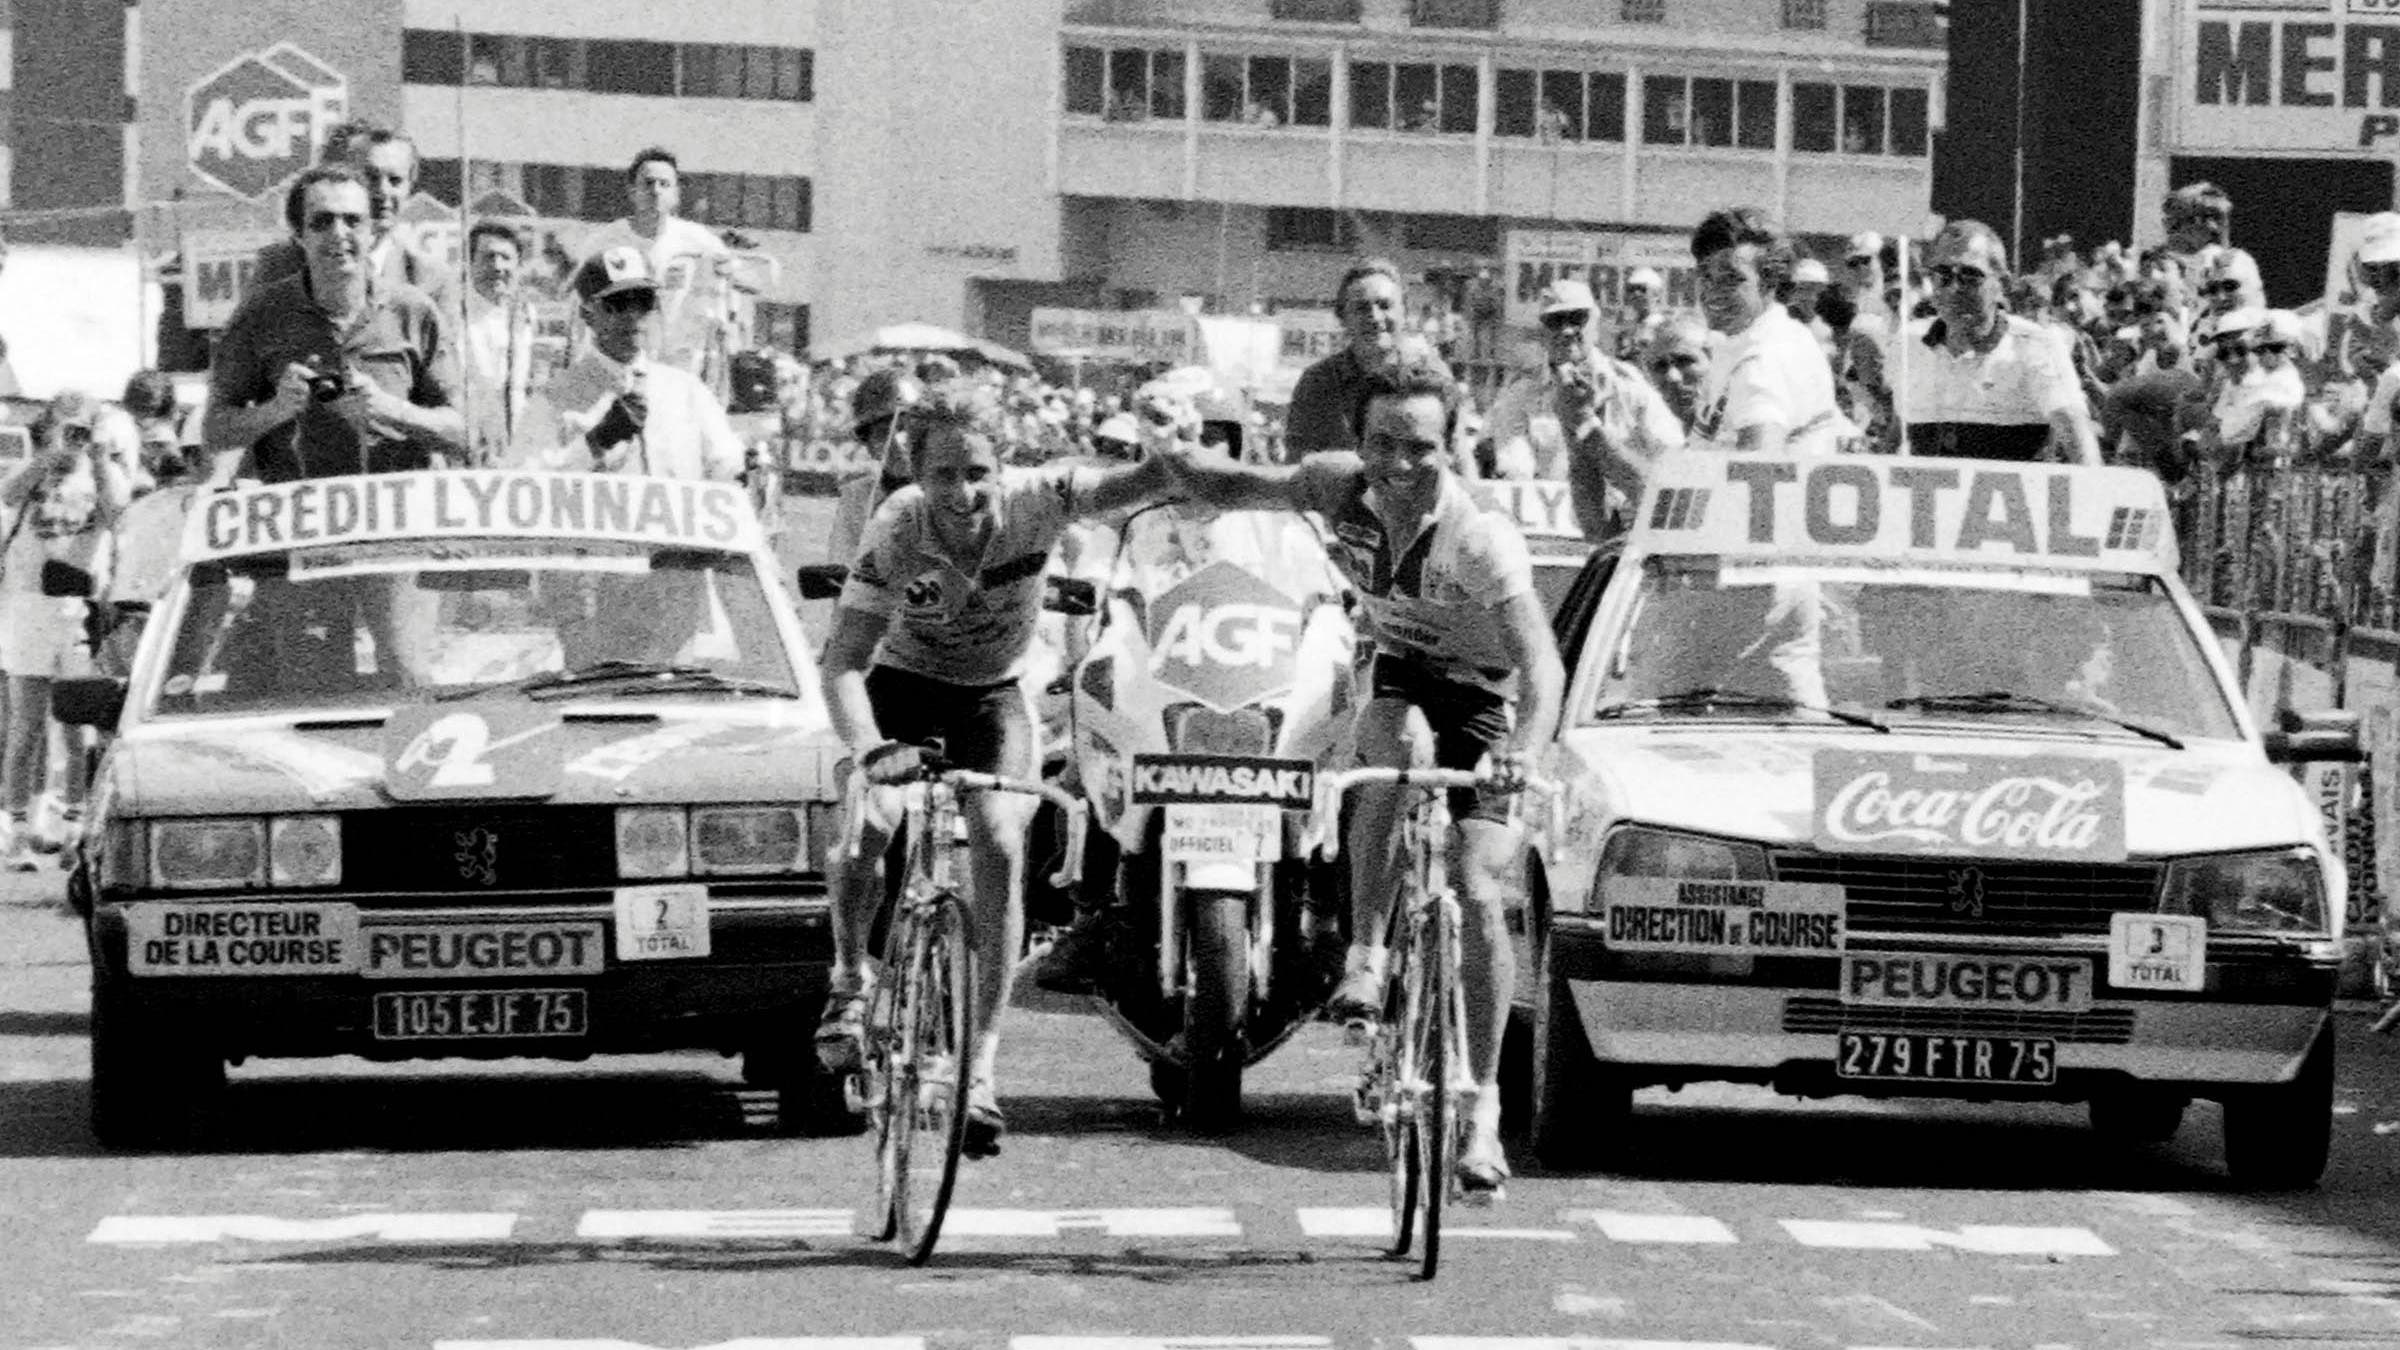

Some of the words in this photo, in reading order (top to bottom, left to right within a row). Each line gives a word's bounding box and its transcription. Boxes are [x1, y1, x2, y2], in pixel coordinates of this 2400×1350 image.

[189, 97, 318, 160] AGF
[206, 478, 415, 549] CREDIT
[435, 476, 739, 542] LYONNAIS
[1727, 462, 2099, 556] TOTAL
[1149, 603, 1300, 668] AGF
[430, 713, 495, 787] 2
[1134, 764, 1311, 798] KAWASAKI
[1825, 771, 2109, 848] Coca-Cola
[164, 911, 321, 937] DIRECTEUR
[655, 899, 668, 930] 2
[1611, 905, 1726, 945] DIRECTION
[1750, 910, 1839, 949] COURSE
[145, 940, 183, 965] DE
[188, 940, 220, 965] LA
[228, 938, 342, 965] COURSE
[369, 931, 593, 971] PEUGEOT
[635, 936, 691, 953] TOTAL
[1851, 958, 2083, 1002] PEUGEOT
[2131, 965, 2181, 982] TOTAL
[395, 996, 452, 1034] 105
[460, 995, 520, 1033] EJF
[534, 994, 573, 1032] 75
[1845, 1036, 1912, 1075] 279
[1926, 1040, 1993, 1078] FTR
[2009, 1042, 2052, 1080] 75
